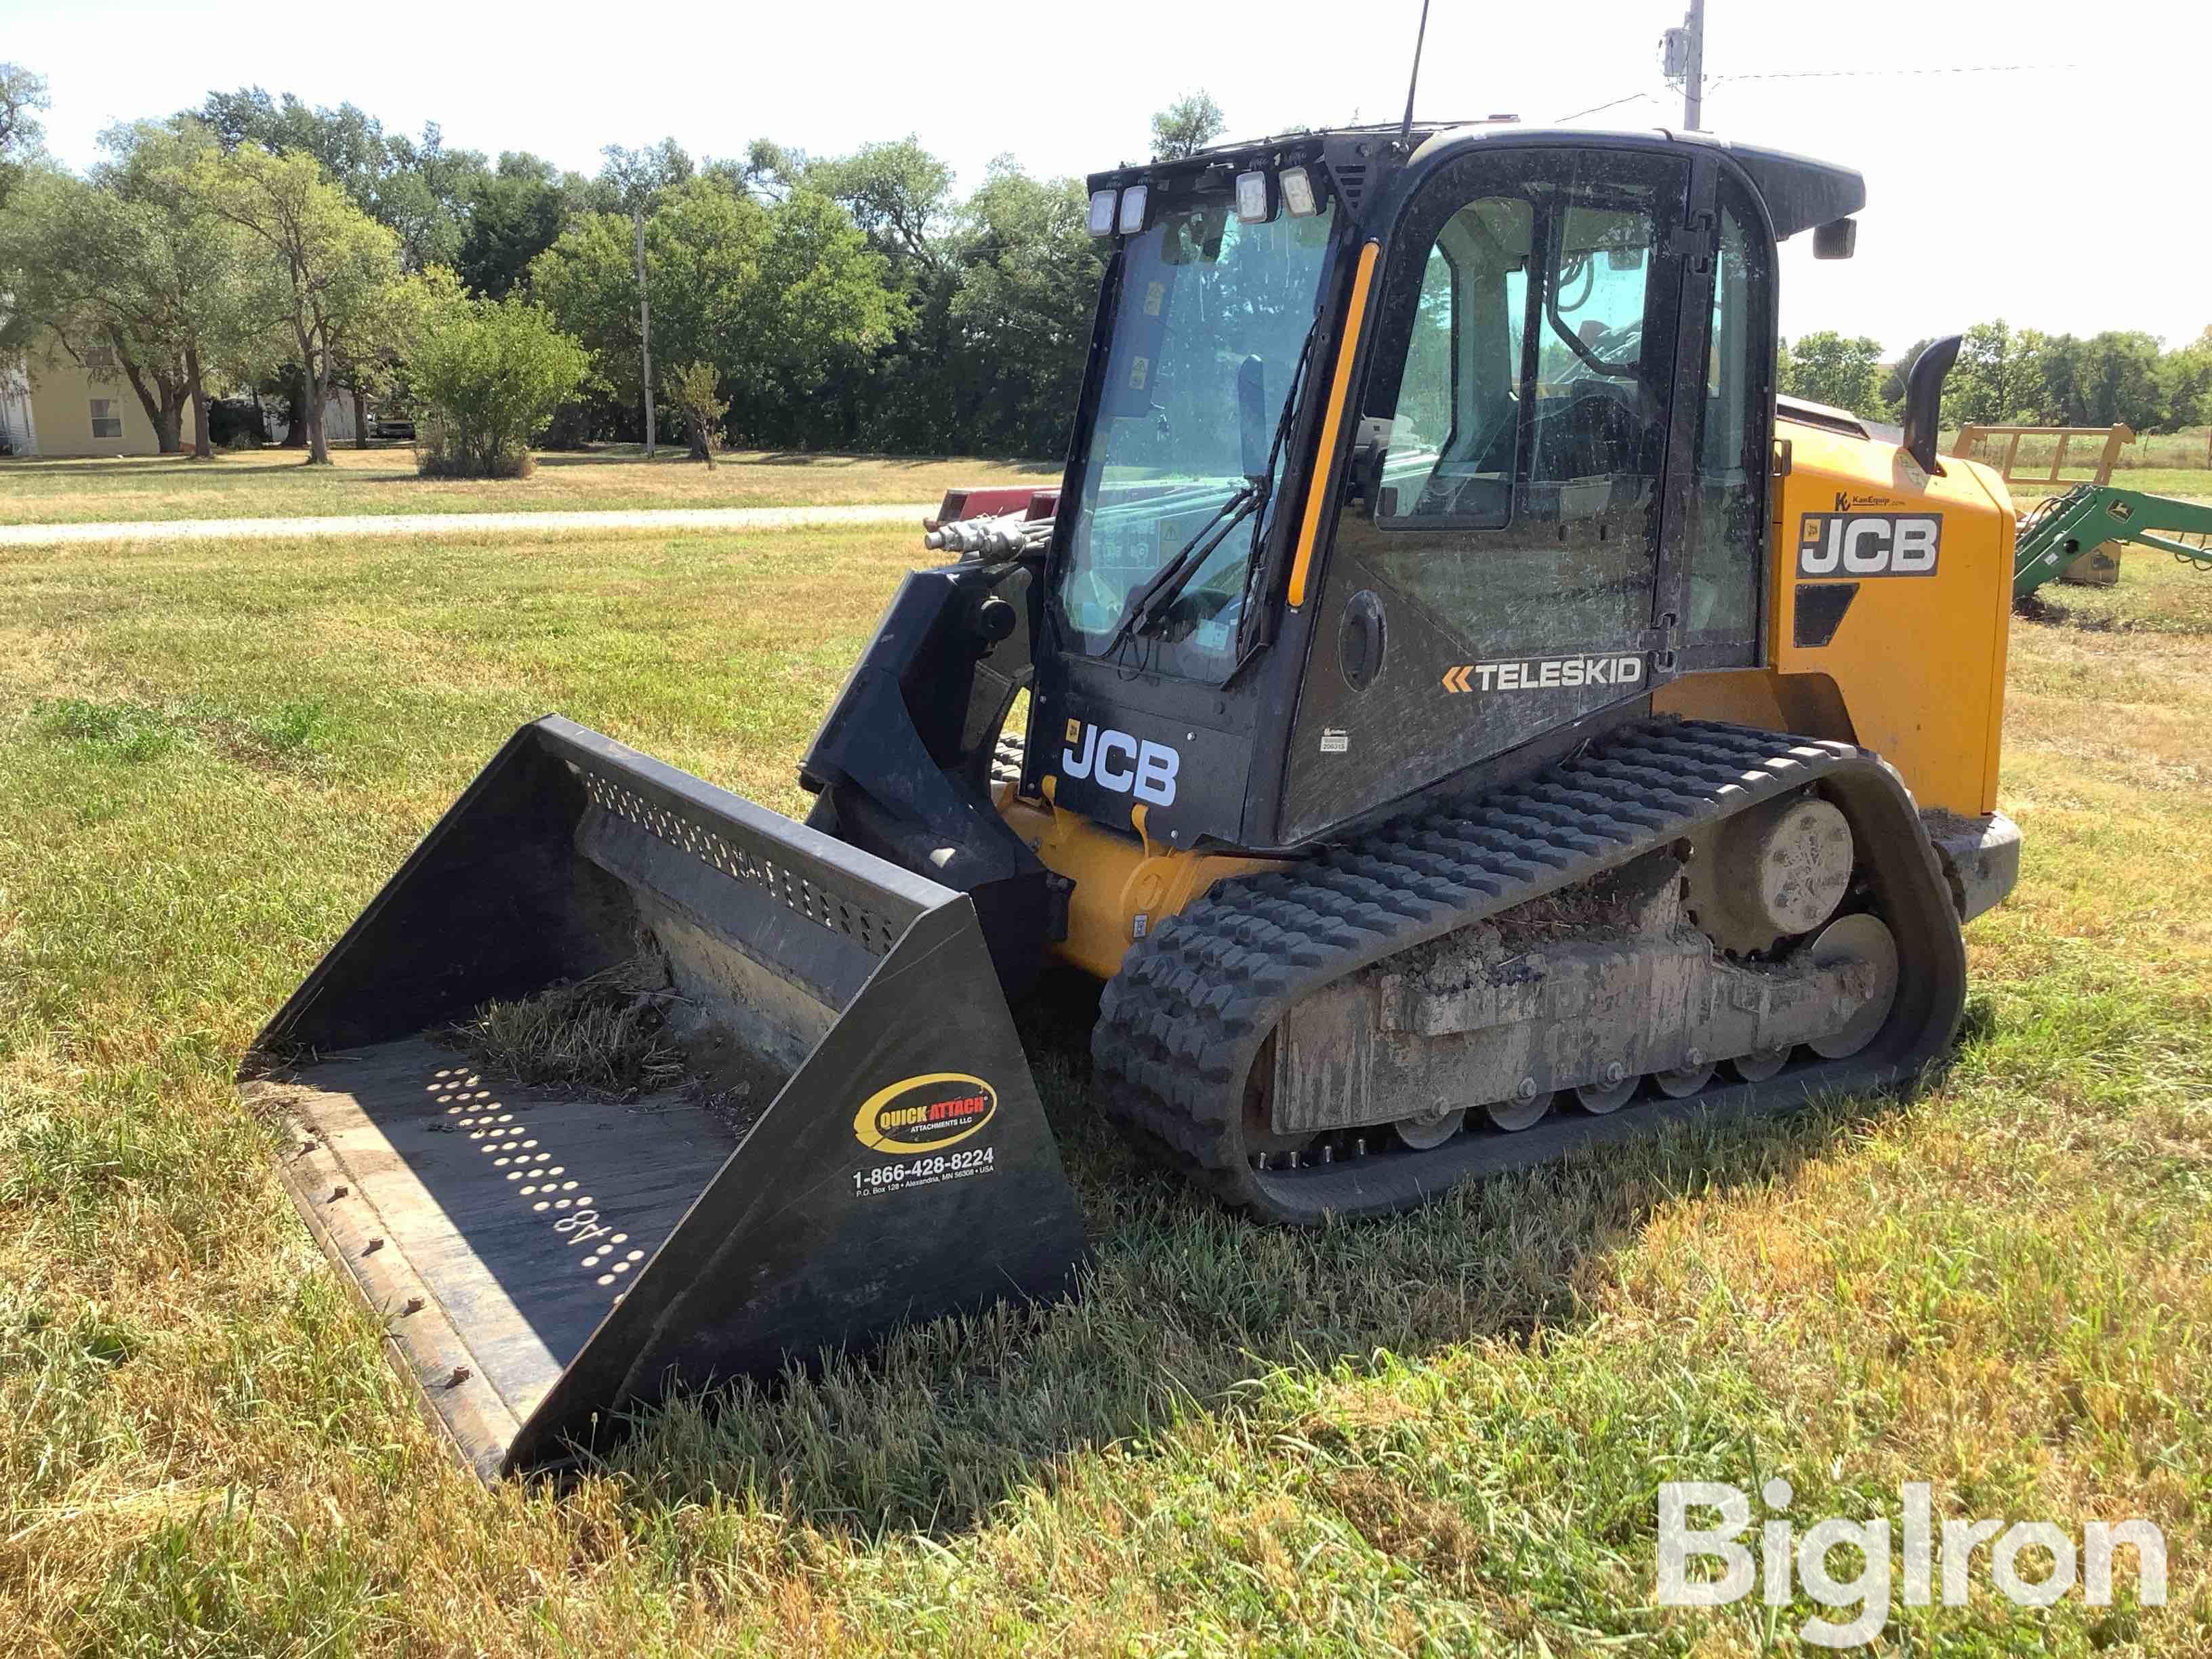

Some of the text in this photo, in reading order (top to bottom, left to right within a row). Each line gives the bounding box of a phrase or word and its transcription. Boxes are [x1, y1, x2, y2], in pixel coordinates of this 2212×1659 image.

[1801, 518, 1937, 573] JCB
[1475, 657, 1641, 691] TELESKID
[1062, 723, 1180, 806] JCB
[880, 1096, 984, 1130] QUICK ATTACH
[911, 1116, 972, 1133] ATTACHMENTS LLC
[853, 1147, 994, 1189] 1-866-428-8224
[856, 1188, 872, 1197] P.O.
[872, 1186, 886, 1194] Box
[942, 1172, 954, 1181] MN
[979, 1165, 994, 1173] USA
